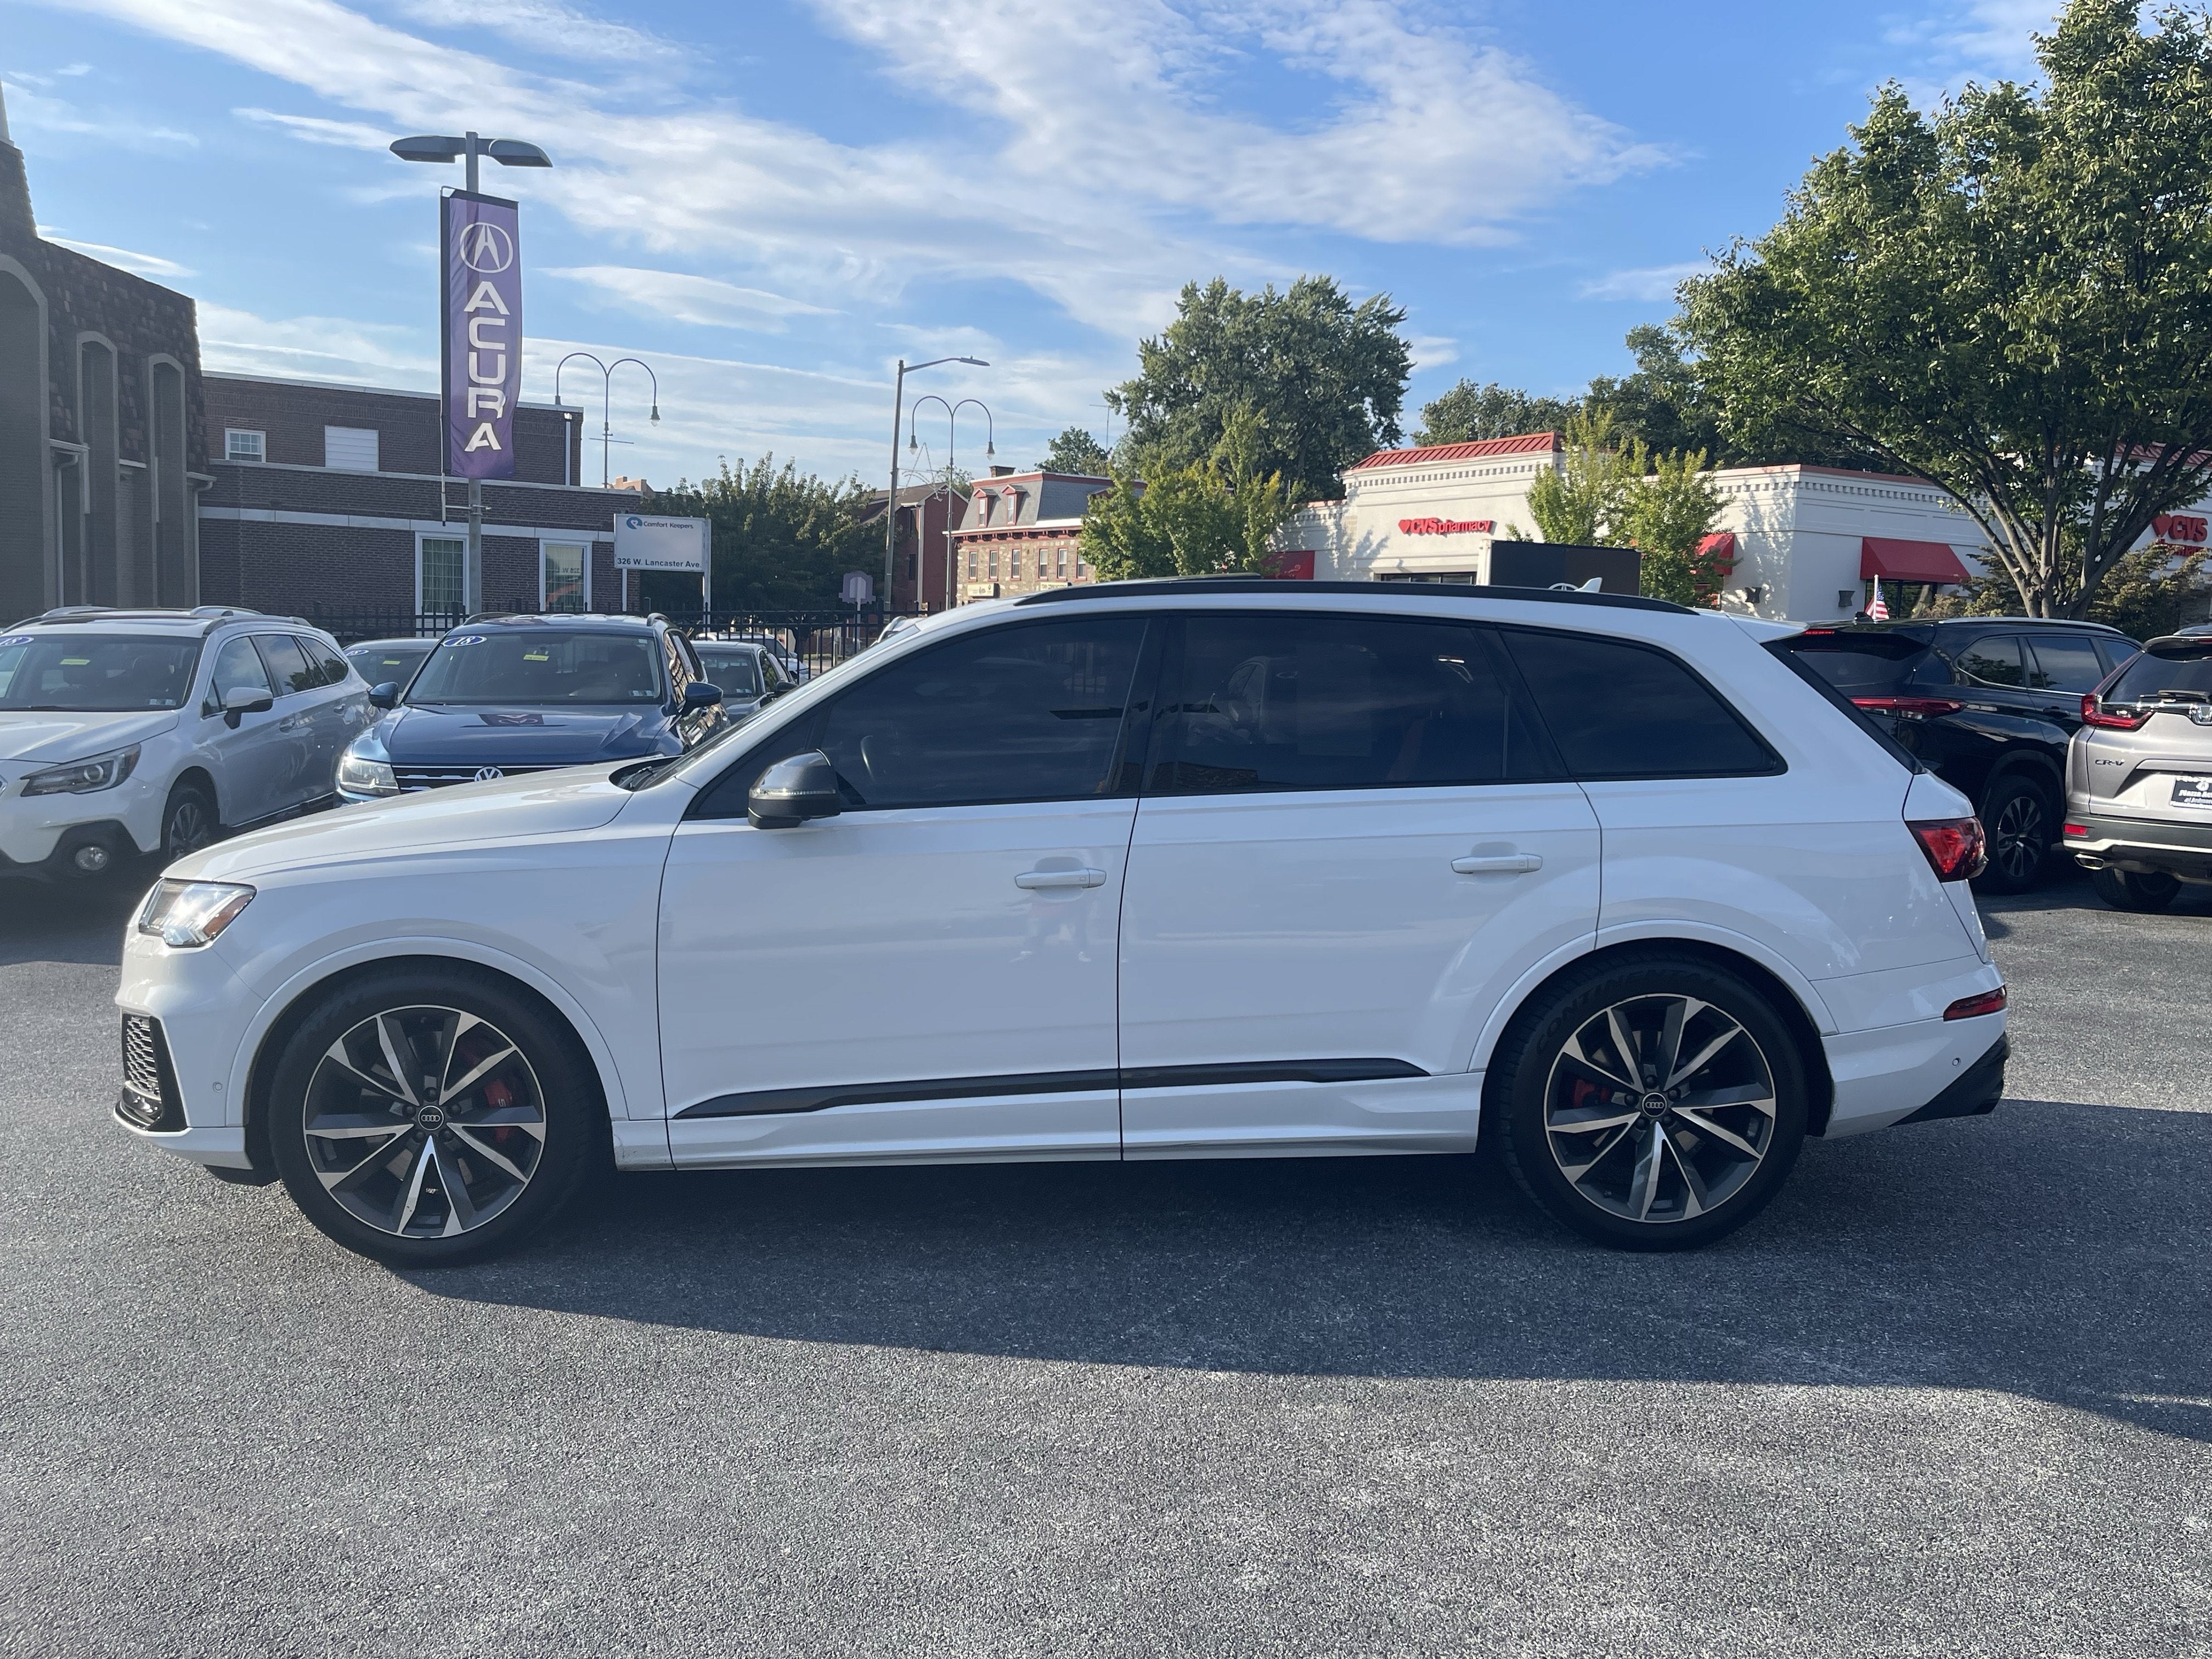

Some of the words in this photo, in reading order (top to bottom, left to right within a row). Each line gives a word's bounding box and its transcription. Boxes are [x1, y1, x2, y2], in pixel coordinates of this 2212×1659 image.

[464, 281, 511, 452] ACURA
[1410, 517, 1440, 534] CVS
[1438, 520, 1491, 535] pharmacy
[2169, 515, 2208, 542] CVS
[645, 559, 684, 567] Lancaster
[452, 636, 475, 646] 18
